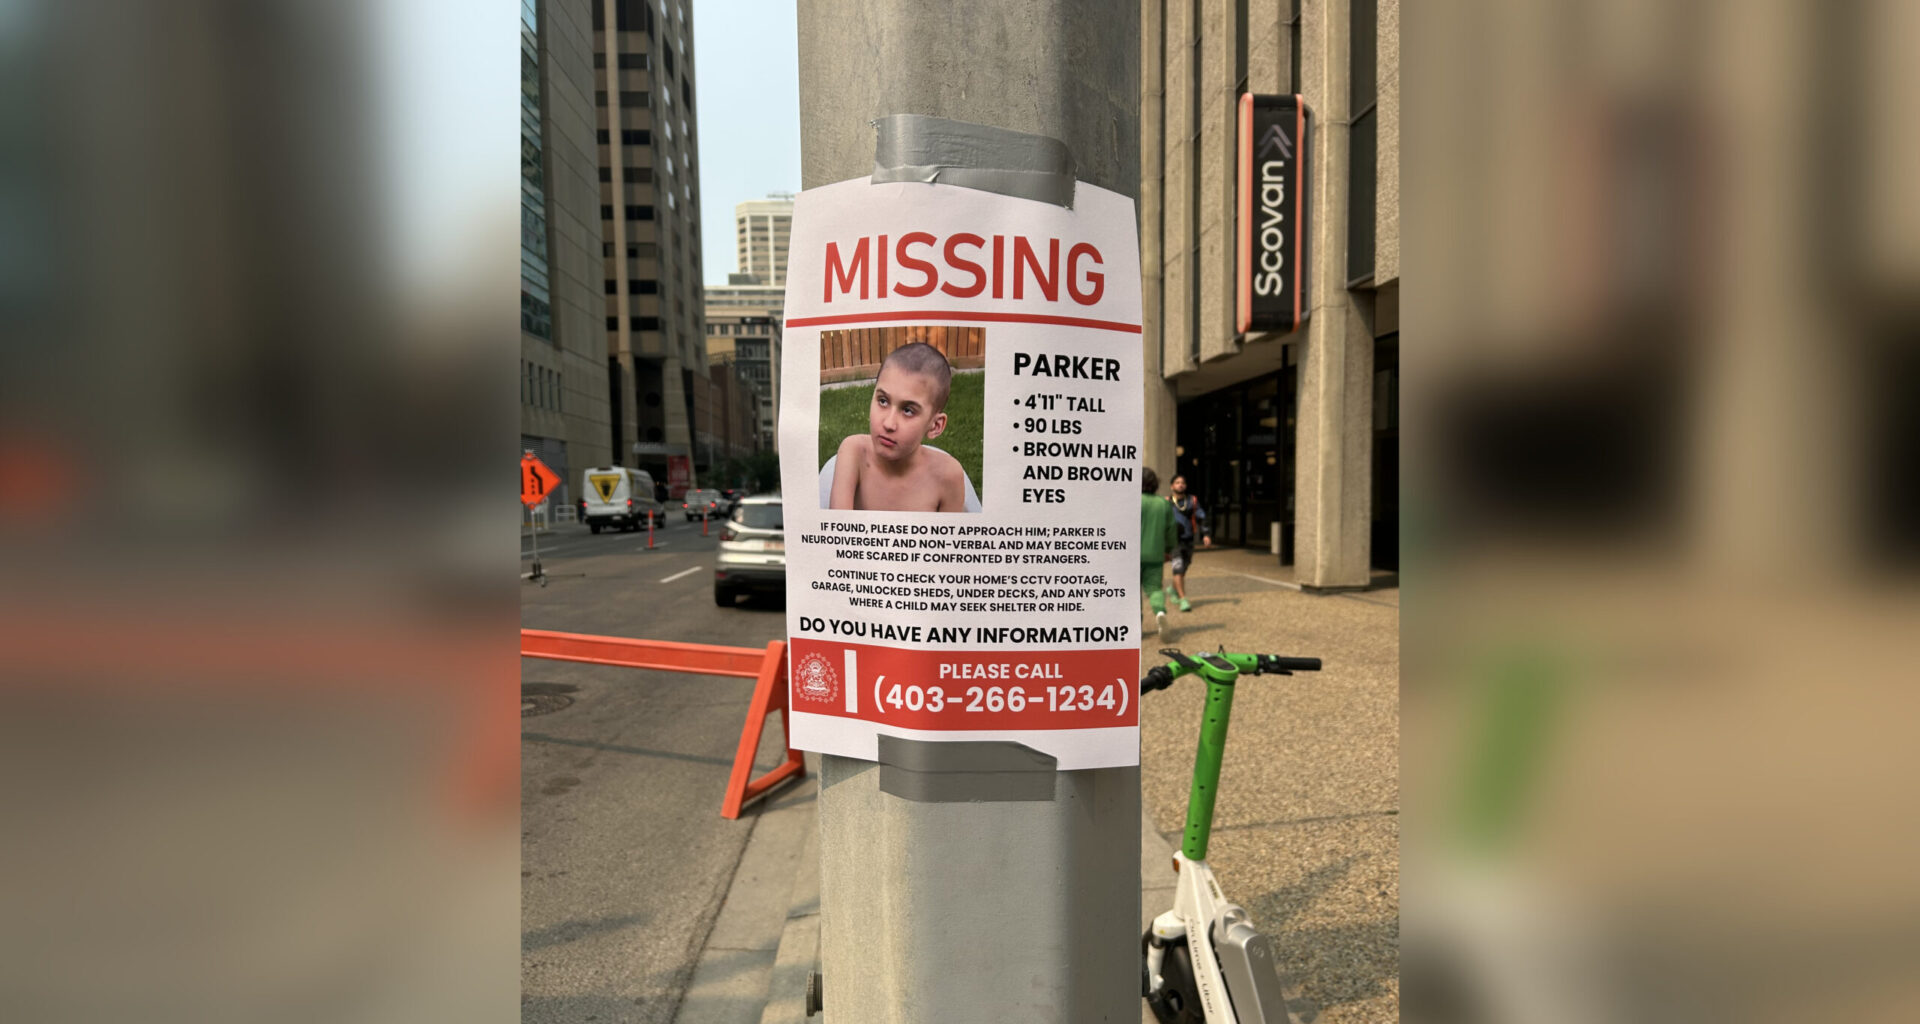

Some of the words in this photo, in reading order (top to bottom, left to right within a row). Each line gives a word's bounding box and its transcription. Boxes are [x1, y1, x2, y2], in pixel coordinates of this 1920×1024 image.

[1254, 160, 1285, 297] Scovan
[824, 232, 1104, 306] MISSING
[1014, 352, 1120, 381] PARKER
[1066, 396, 1105, 413] TALL
[1025, 417, 1047, 433] 90
[1052, 419, 1082, 435] LBS
[1024, 442, 1093, 458] BROWN
[1097, 444, 1137, 459] HAIR
[1023, 465, 1063, 480] AND
[1068, 466, 1132, 482] BROWN
[1023, 488, 1065, 503] EYES
[821, 522, 829, 531] IF
[831, 523, 868, 534] FOUND,
[871, 524, 908, 534] PLEASE
[911, 525, 928, 535] DO
[931, 526, 955, 535] NOT
[958, 526, 1022, 536] APPROACH
[1025, 527, 1050, 538] HIM;
[1053, 527, 1094, 536] PARKER
[1097, 528, 1106, 537] IS
[802, 535, 890, 547] NEURODIVERGENT
[892, 539, 916, 548] AND
[919, 539, 996, 549] NON-VERBAL
[998, 541, 1024, 550] AND
[1026, 541, 1052, 550] MAY
[1054, 541, 1099, 550] BECOME
[1101, 541, 1126, 550] EVEN
[836, 550, 864, 559] MORE
[866, 551, 909, 561] SCARED
[911, 553, 920, 562] IF
[923, 553, 1002, 563] CONFRONTED
[1005, 555, 1020, 563] BY
[1023, 555, 1090, 564] STRANGERS.
[828, 569, 878, 581] CONTINUE
[880, 573, 894, 582] TO
[897, 574, 935, 583] CHECK
[939, 575, 971, 584] YOUR
[1020, 575, 1052, 584] CCTV
[1054, 575, 1107, 585] FOOTAGE,
[812, 581, 853, 593] GARAGE,
[856, 585, 912, 597] UNLOCKED
[914, 588, 954, 599] SHEDS,
[957, 589, 995, 598] UNDER
[998, 589, 1038, 599] DECKS,
[1041, 589, 1065, 598] AND
[1068, 589, 1090, 598] ANY
[1093, 588, 1125, 598] SPOTS
[849, 597, 883, 608] WHERE
[885, 600, 892, 609] A
[895, 601, 928, 611] CHILD
[931, 602, 957, 611] MAY
[960, 603, 987, 612] SEEK
[990, 603, 1036, 612] SHELTER
[1039, 603, 1054, 612] OR
[1057, 603, 1085, 611] HIDE.
[800, 617, 825, 632] DO
[829, 619, 866, 636] YOU
[871, 623, 921, 642] HAVE
[926, 627, 972, 643] ANY
[977, 625, 1128, 643] INFORMATION?
[940, 664, 1010, 679] PLEASE
[1015, 663, 1063, 679] CALL
[874, 675, 1129, 716] (403-266-1234)
